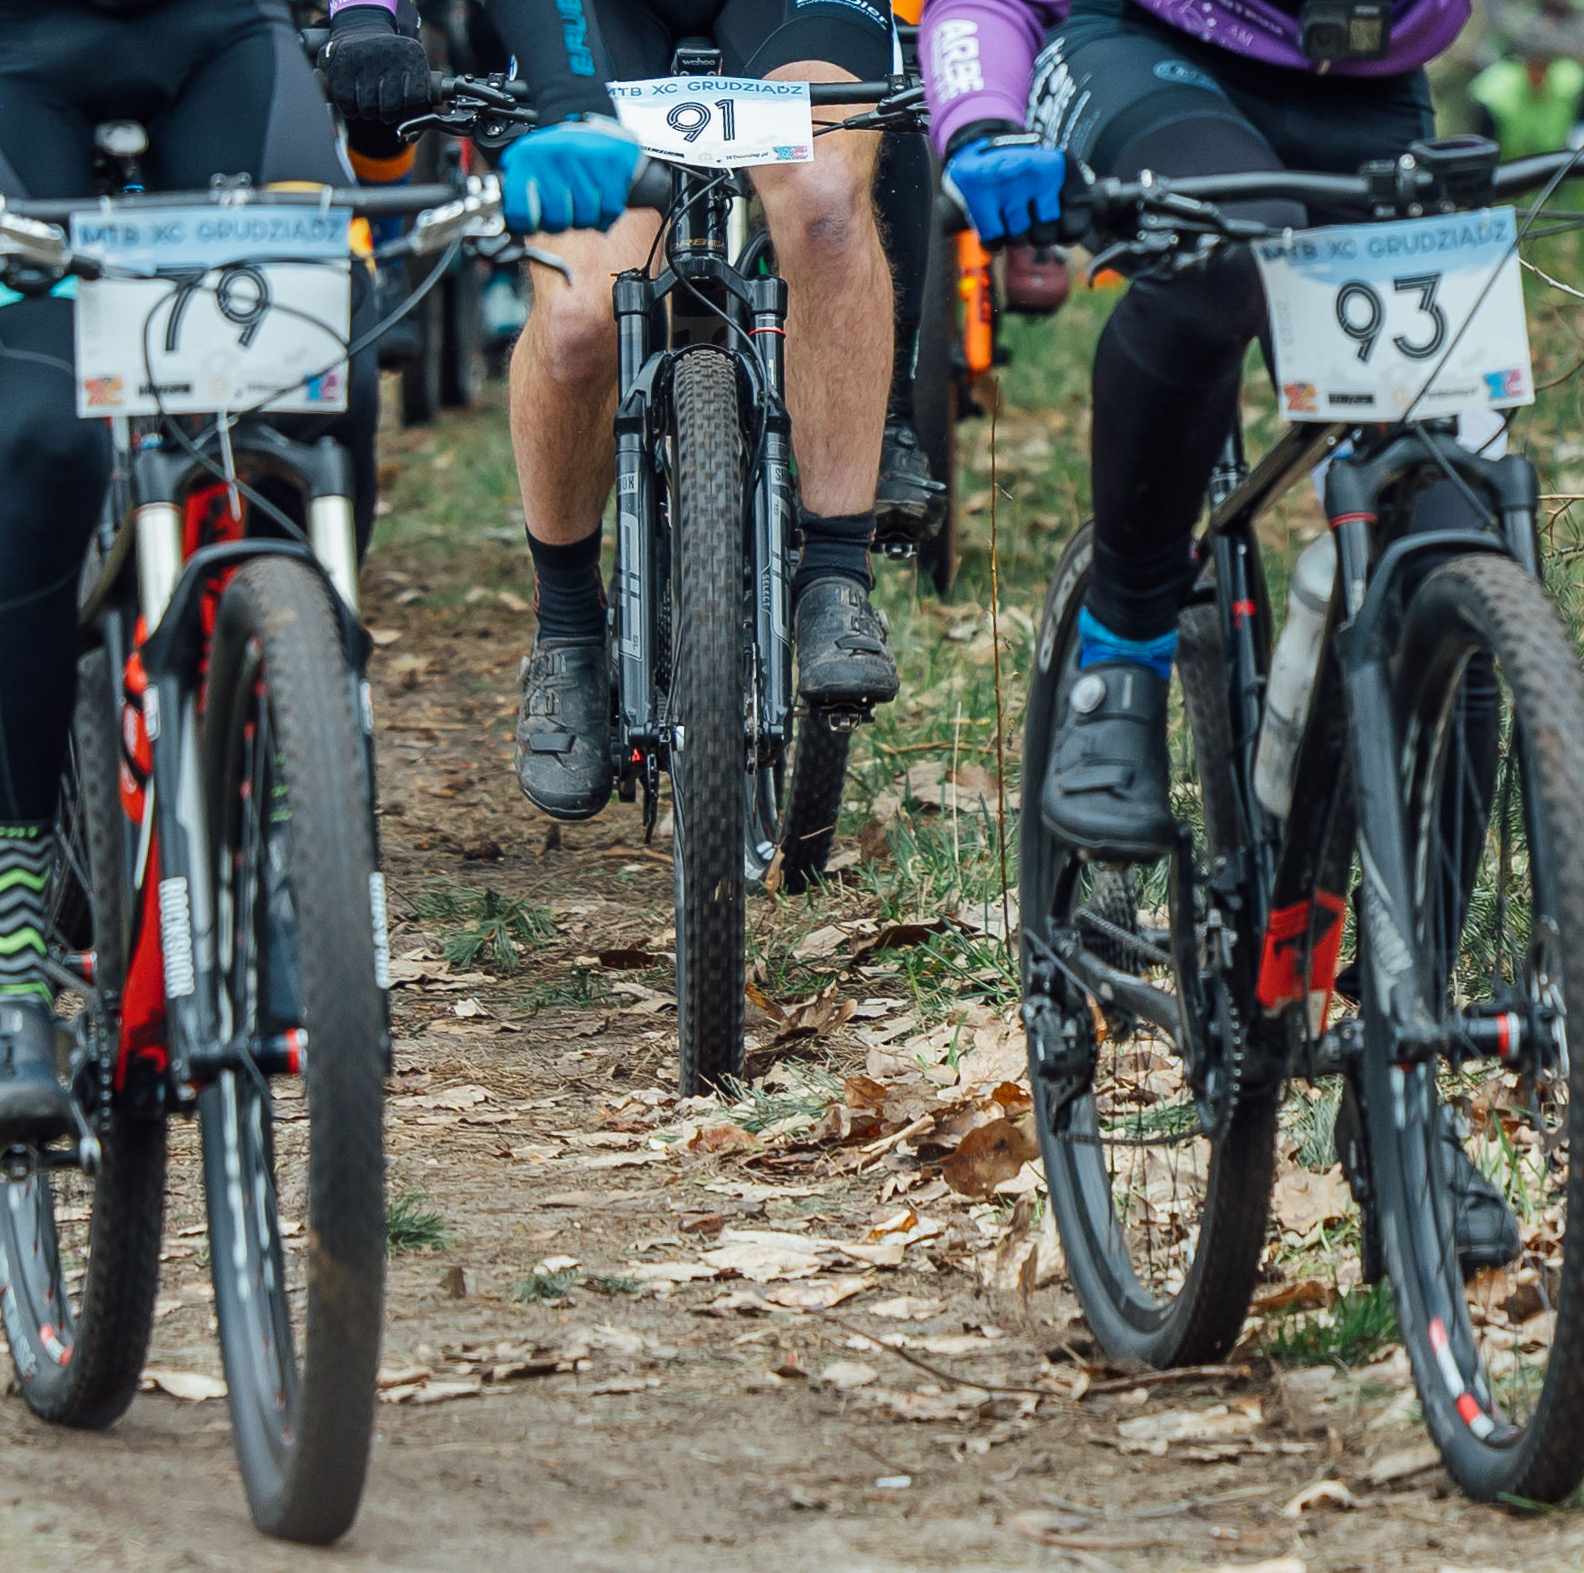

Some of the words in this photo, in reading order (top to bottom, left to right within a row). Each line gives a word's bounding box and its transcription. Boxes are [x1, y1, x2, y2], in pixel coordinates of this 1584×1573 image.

[682, 57, 716, 66] wahoo
[651, 83, 678, 95] XC
[666, 98, 735, 143] 91
[82, 224, 141, 245] MTB
[152, 223, 187, 244] XC
[1262, 241, 1319, 261] MTB
[1329, 239, 1357, 259] XC
[156, 263, 269, 352] 79
[1336, 272, 1446, 364] 93
[762, 575, 770, 608] SELECT
